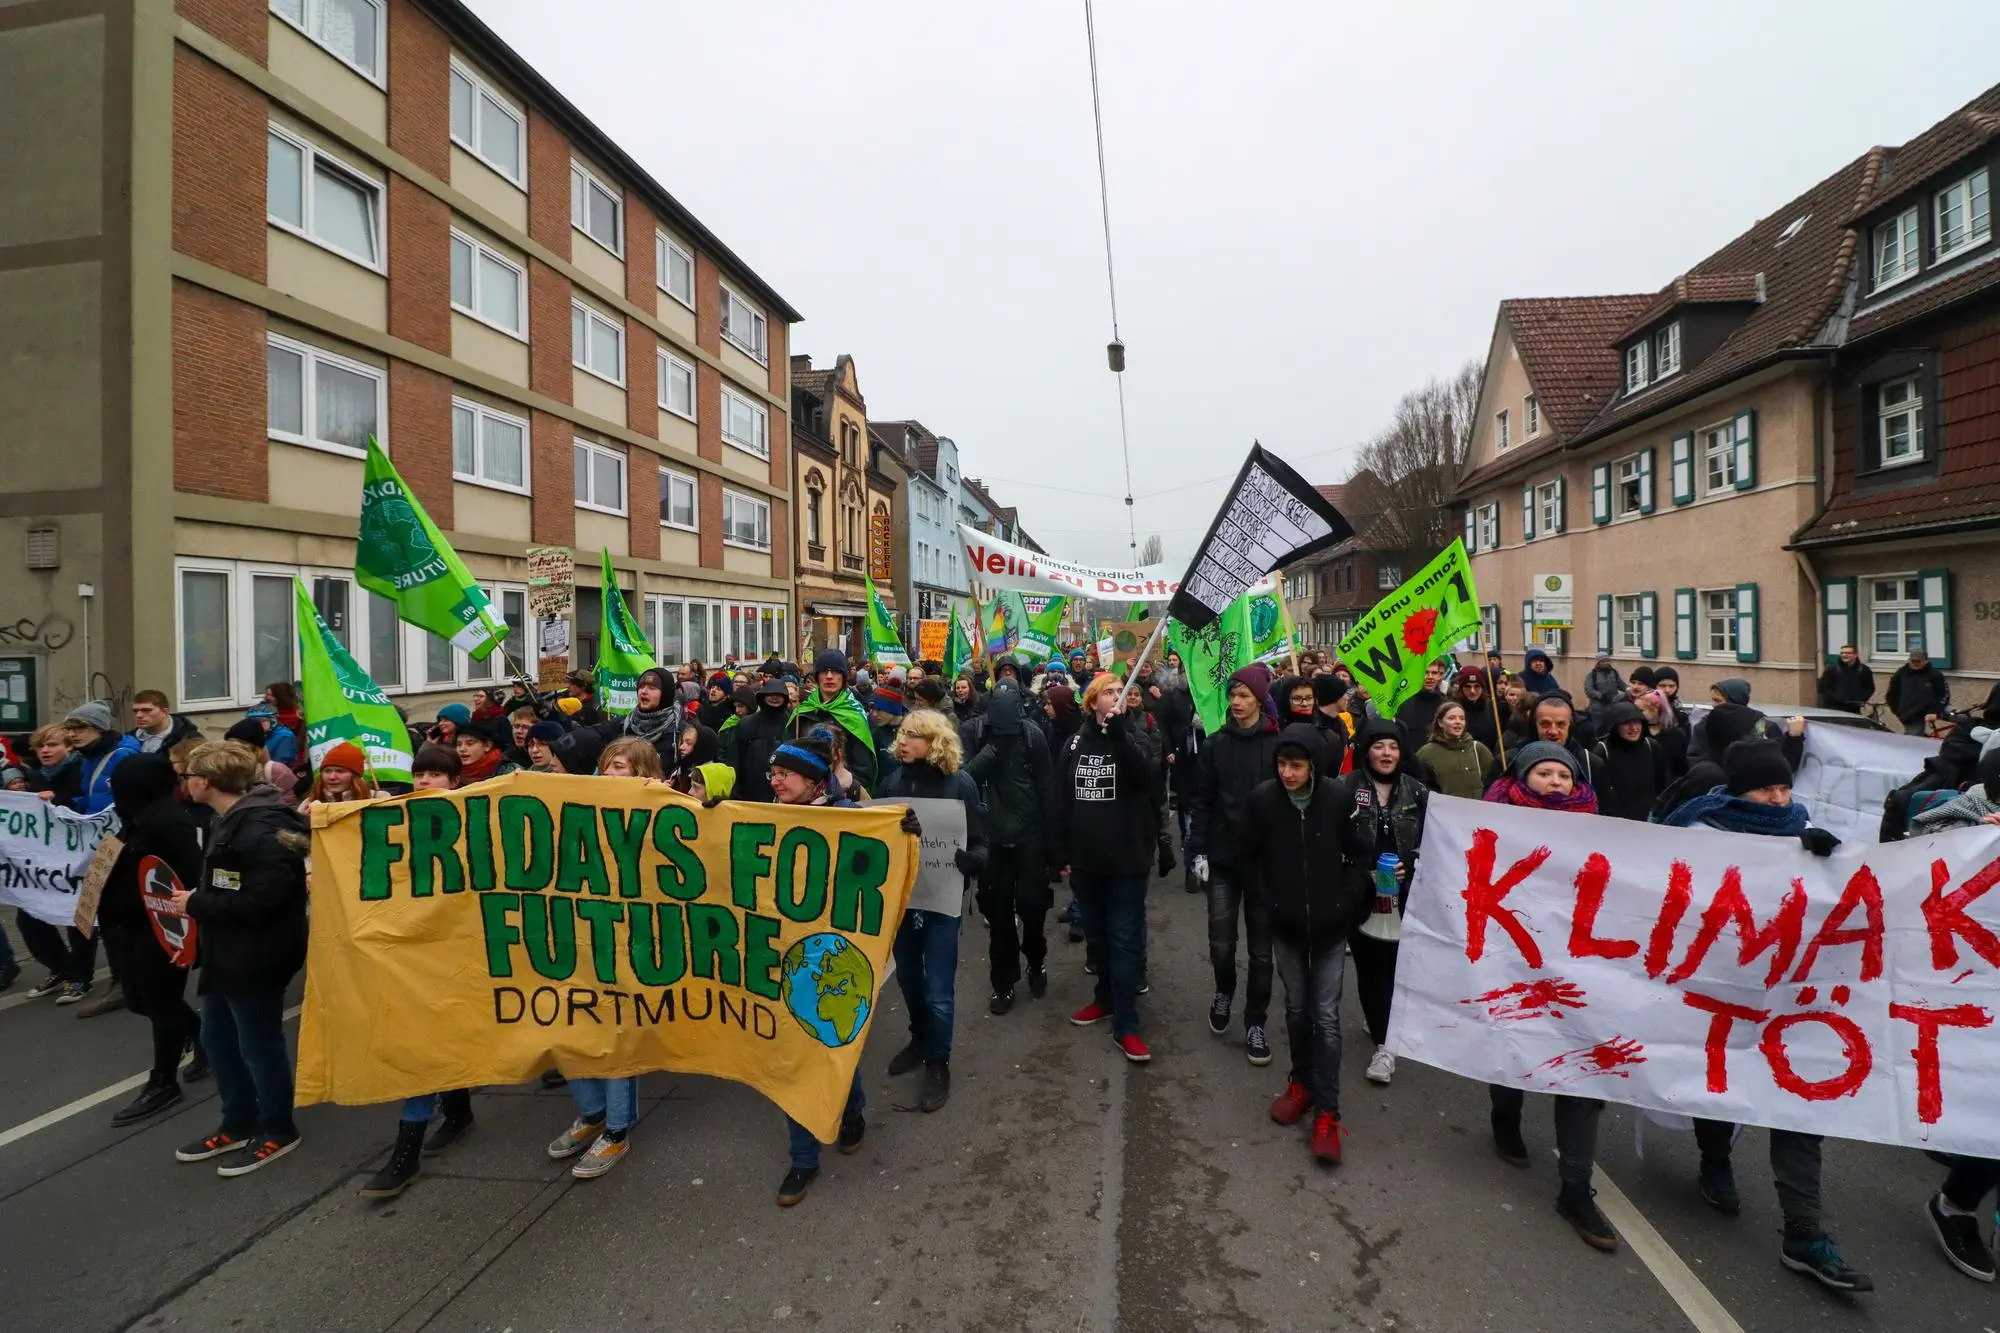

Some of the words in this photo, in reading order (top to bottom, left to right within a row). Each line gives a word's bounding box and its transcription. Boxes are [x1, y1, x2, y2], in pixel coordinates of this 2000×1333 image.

[1239, 483, 1278, 524] RASSISMUS
[1286, 498, 1313, 528] GEGEN
[1218, 520, 1254, 556] SEXISMUS
[1049, 570, 1083, 588] zu
[1097, 578, 1181, 595] Datte
[1023, 596, 1050, 604] OPPEN
[343, 687, 391, 704] UTUR
[1078, 766, 1112, 776] mensch
[1085, 777, 1097, 788] ist
[1077, 788, 1105, 799] illegal
[360, 795, 706, 901] FRIDAYS
[730, 822, 889, 936] FOR
[481, 892, 783, 1001] FUTURE
[494, 986, 777, 1040] DORTMUND
[1683, 984, 1994, 1128] TÖT
